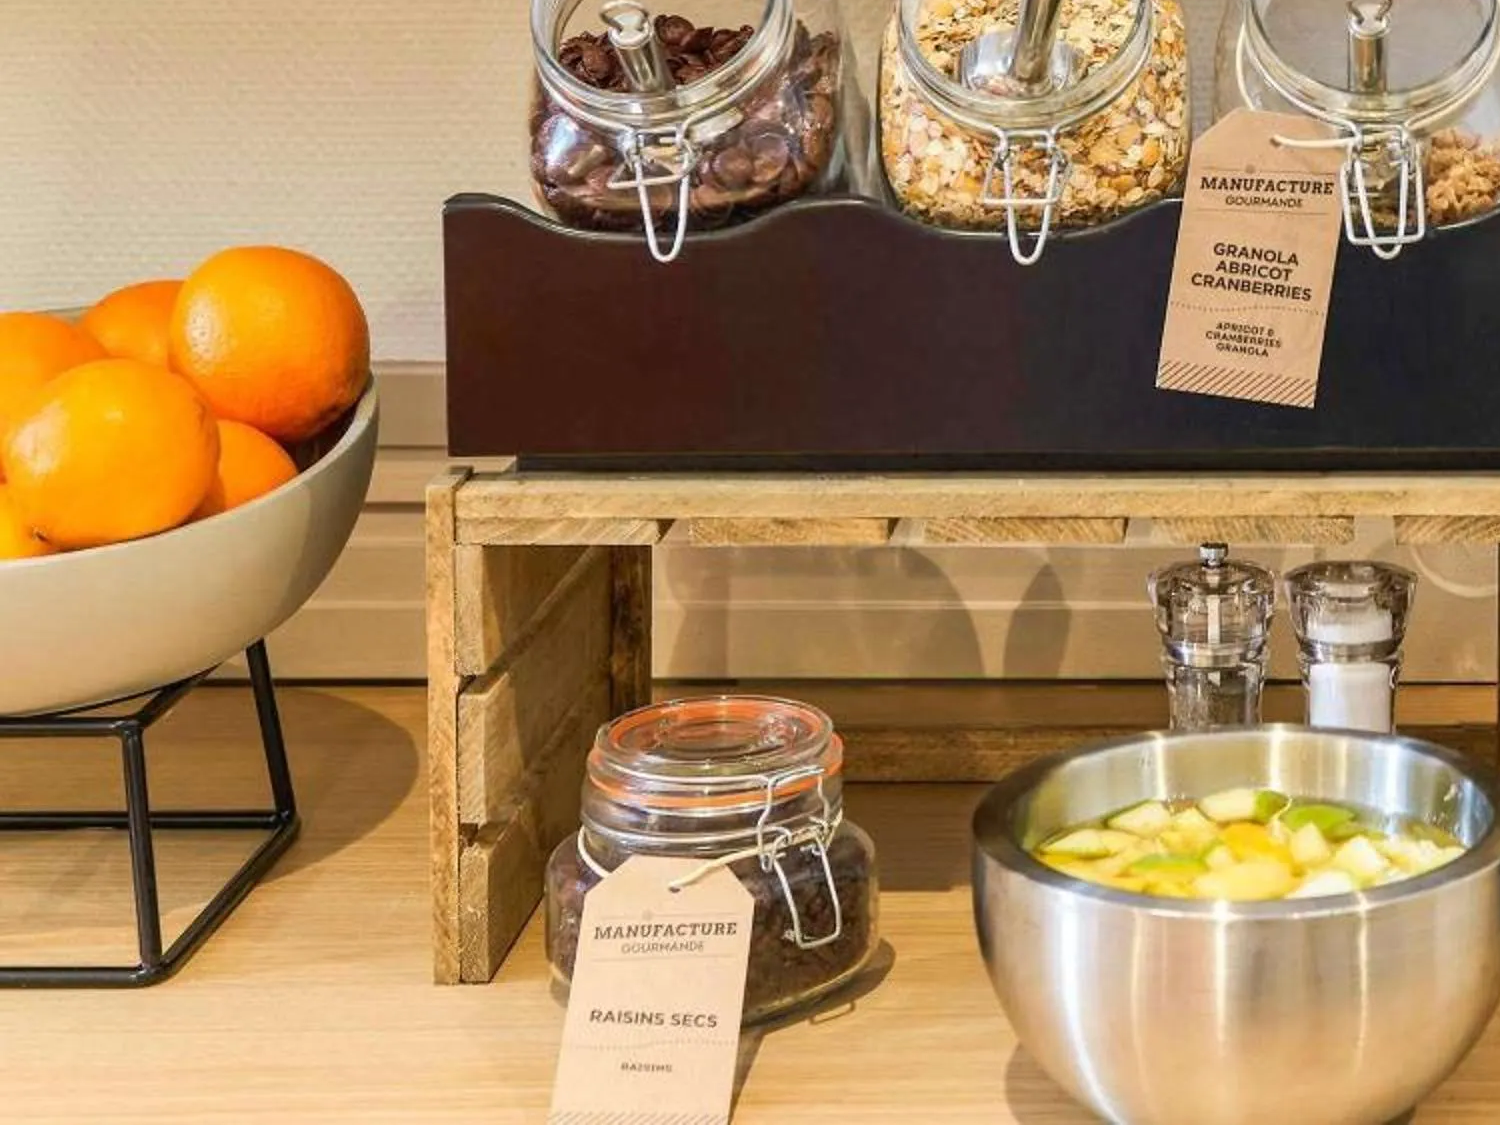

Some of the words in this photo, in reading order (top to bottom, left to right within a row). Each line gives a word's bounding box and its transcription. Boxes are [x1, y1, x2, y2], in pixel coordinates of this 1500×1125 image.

[1200, 176, 1335, 196] MANUFACTURE
[1225, 195, 1303, 209] GOURMANDE
[1213, 242, 1299, 267] GRANOLA
[1215, 260, 1293, 282] ABRICOT
[1191, 273, 1313, 302] CRANBERRIES
[1216, 322, 1264, 336] APRICOT
[1215, 343, 1269, 357] GRANOLA
[594, 922, 737, 940] MANUFACTURE
[621, 941, 704, 955] GOURMANDE
[590, 1010, 665, 1026] RAISINS
[671, 1013, 718, 1028] SECS
